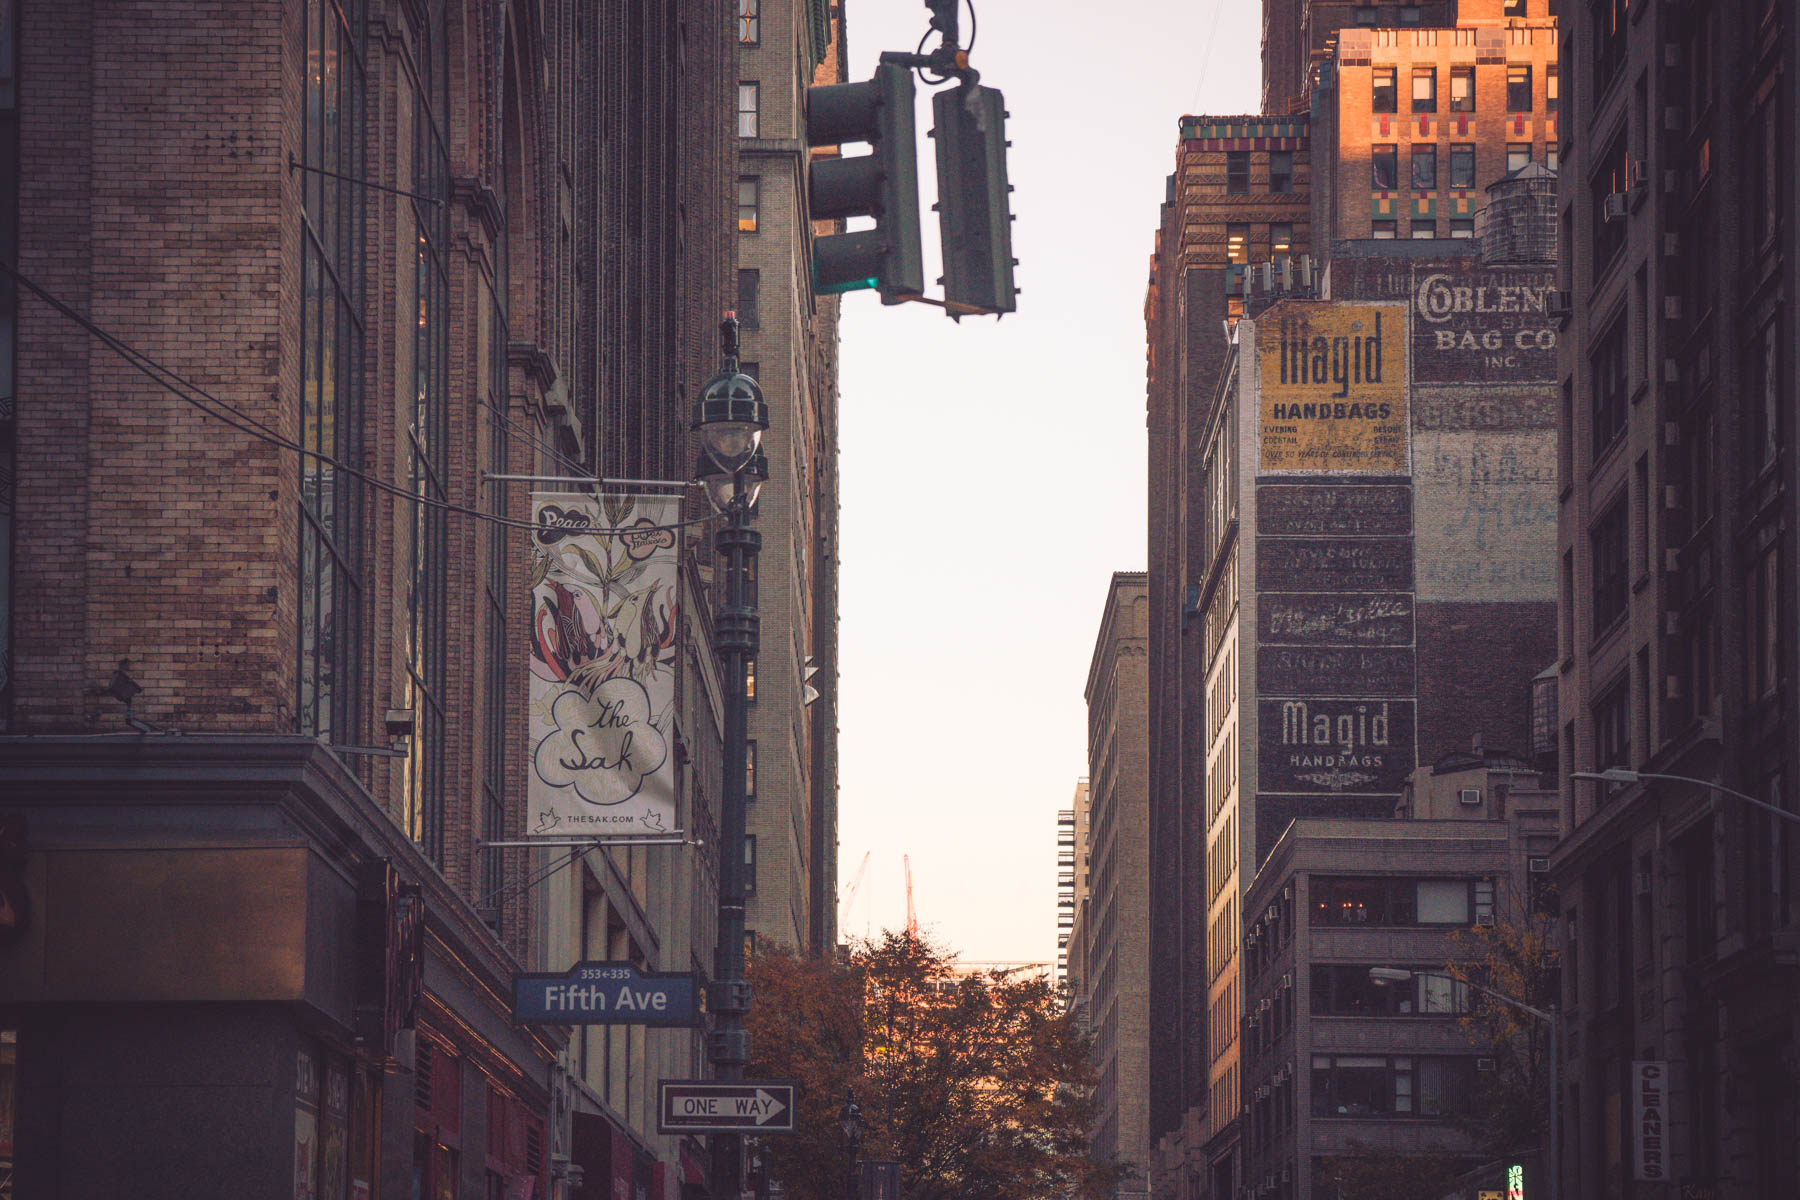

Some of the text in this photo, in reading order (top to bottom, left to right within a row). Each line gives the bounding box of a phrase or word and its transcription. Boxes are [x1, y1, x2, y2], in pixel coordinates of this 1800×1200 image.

[1434, 330, 1503, 350] BAG
[1281, 311, 1382, 398] Magid
[1485, 356, 1521, 368] INC.
[1273, 403, 1391, 420] HANDBAGS
[542, 510, 590, 535] Peace
[1283, 702, 1389, 755] Magid
[560, 729, 633, 771] Sak
[1290, 755, 1383, 767] HANDBAGS
[568, 815, 634, 823] THESAK.COM
[545, 985, 667, 1011] Fifth Ave
[684, 1099, 773, 1114] ONE WAY
[1641, 1065, 1663, 1178] CLEANERS
